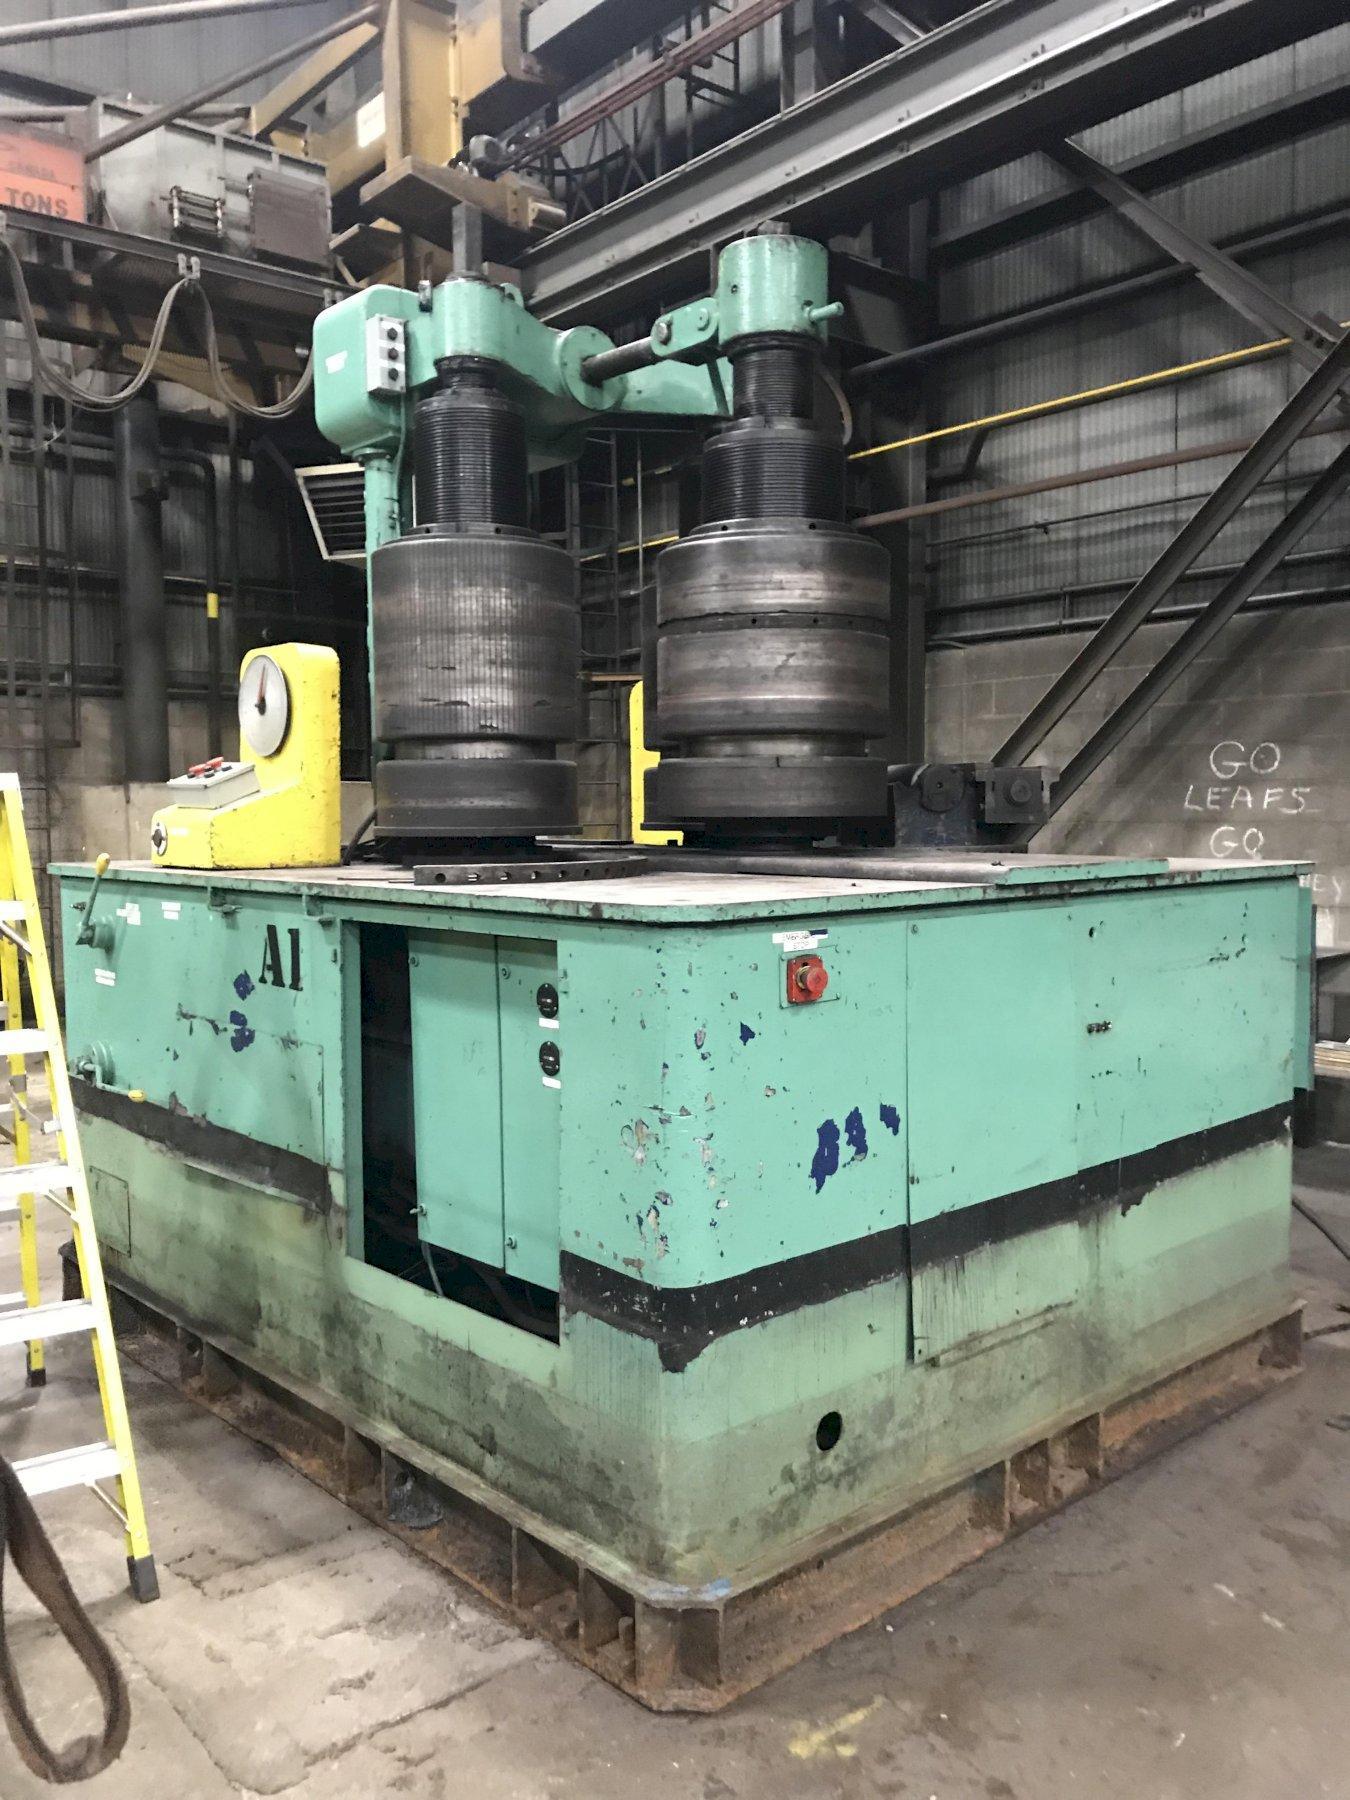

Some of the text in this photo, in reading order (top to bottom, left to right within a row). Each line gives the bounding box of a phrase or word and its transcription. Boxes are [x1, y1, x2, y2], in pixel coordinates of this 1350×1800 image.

[5, 187, 69, 218] TONS
[1210, 741, 1281, 779] GO
[1184, 785, 1311, 815] LEAFS
[1209, 826, 1264, 859] GO
